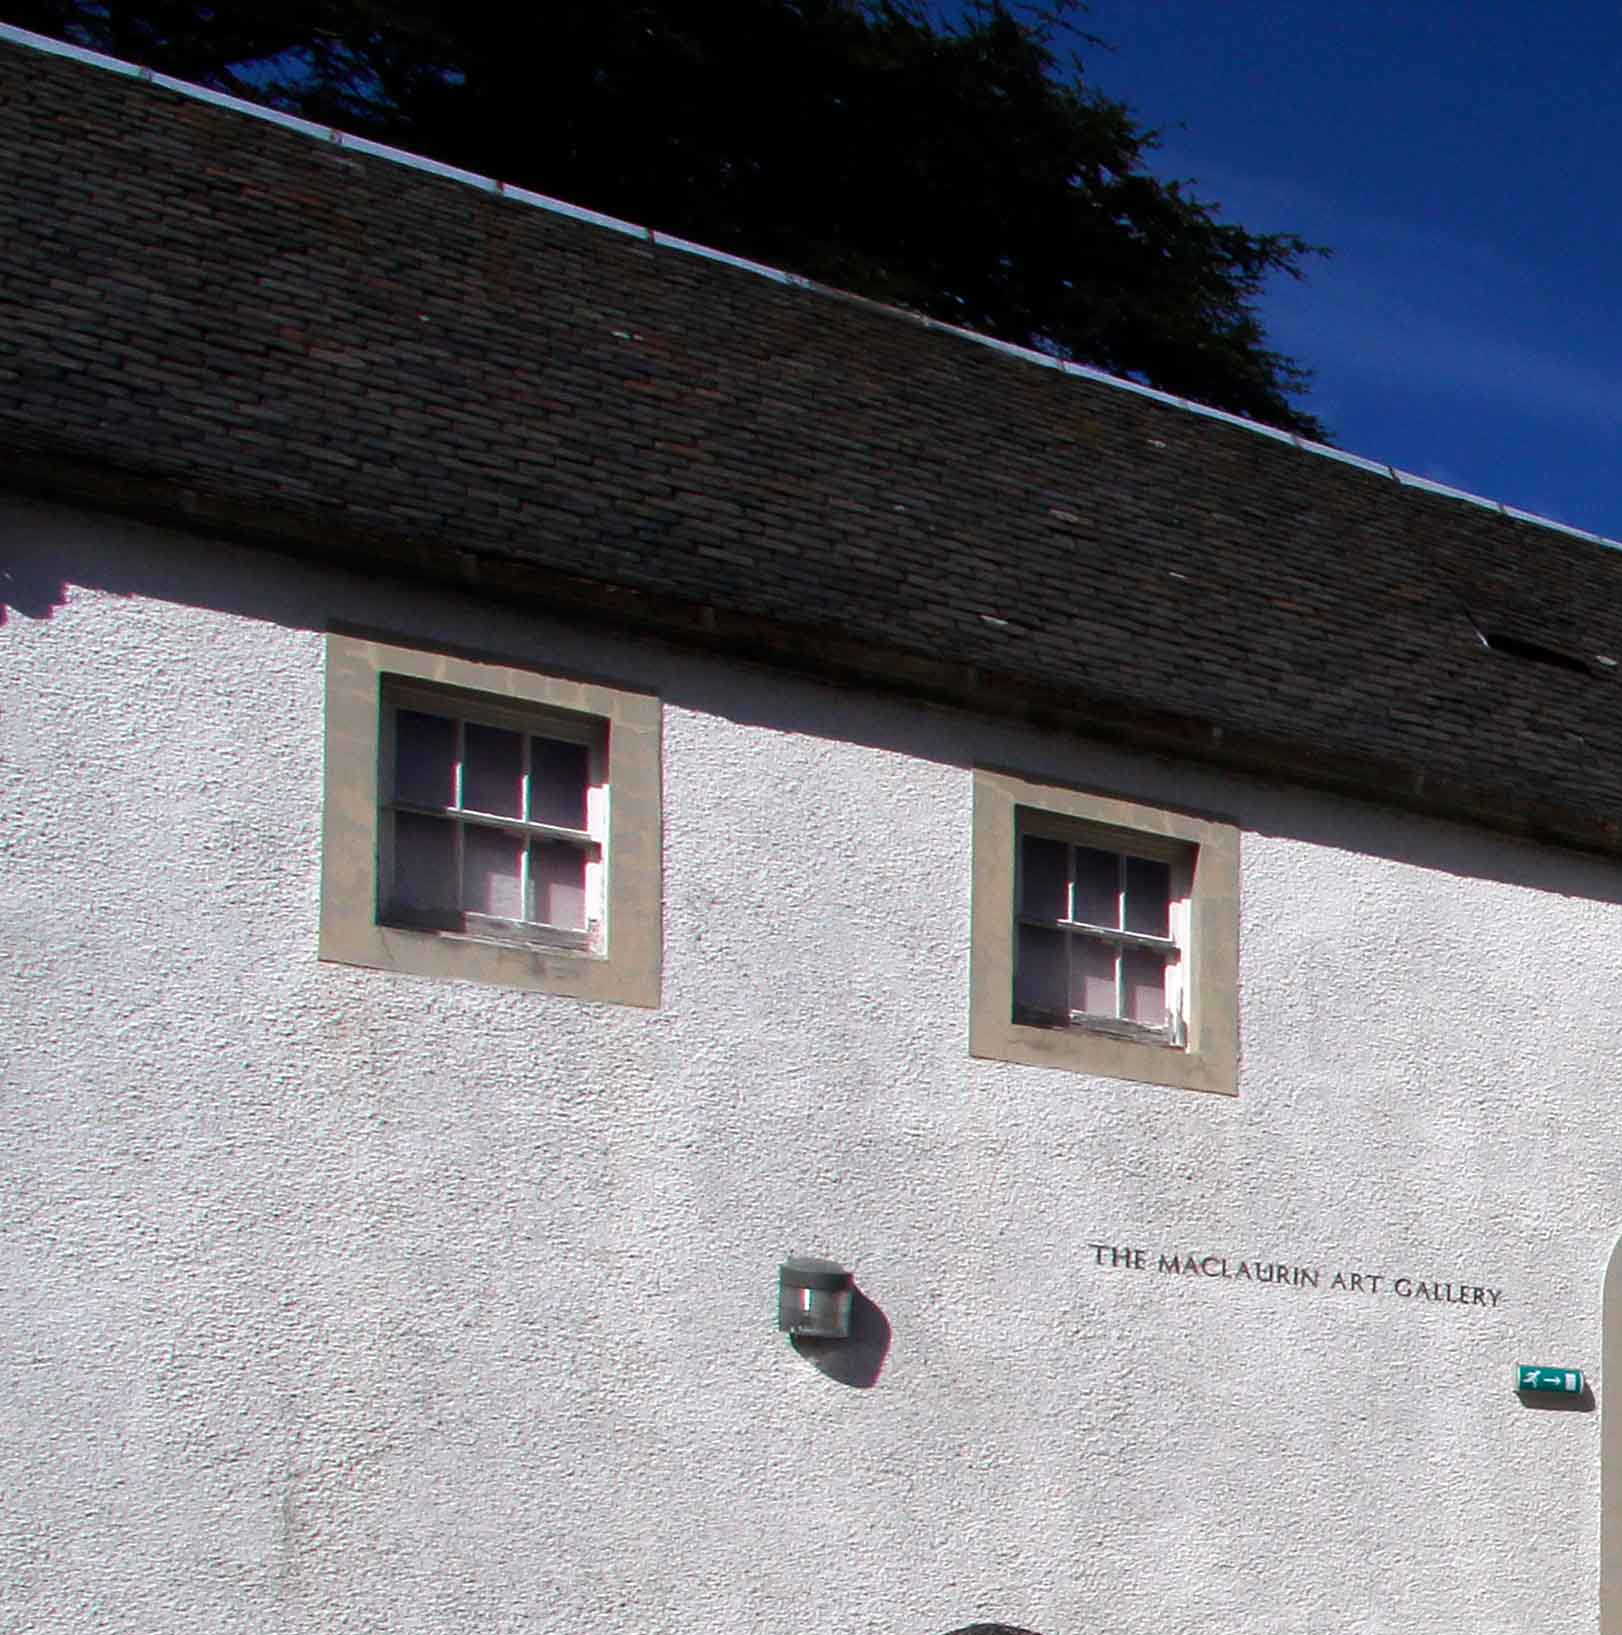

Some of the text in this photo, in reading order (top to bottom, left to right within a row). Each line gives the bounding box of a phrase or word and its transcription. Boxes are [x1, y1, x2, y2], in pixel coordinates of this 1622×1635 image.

[1088, 1243, 1503, 1307] THE MACLAURIN ART GALLERY
